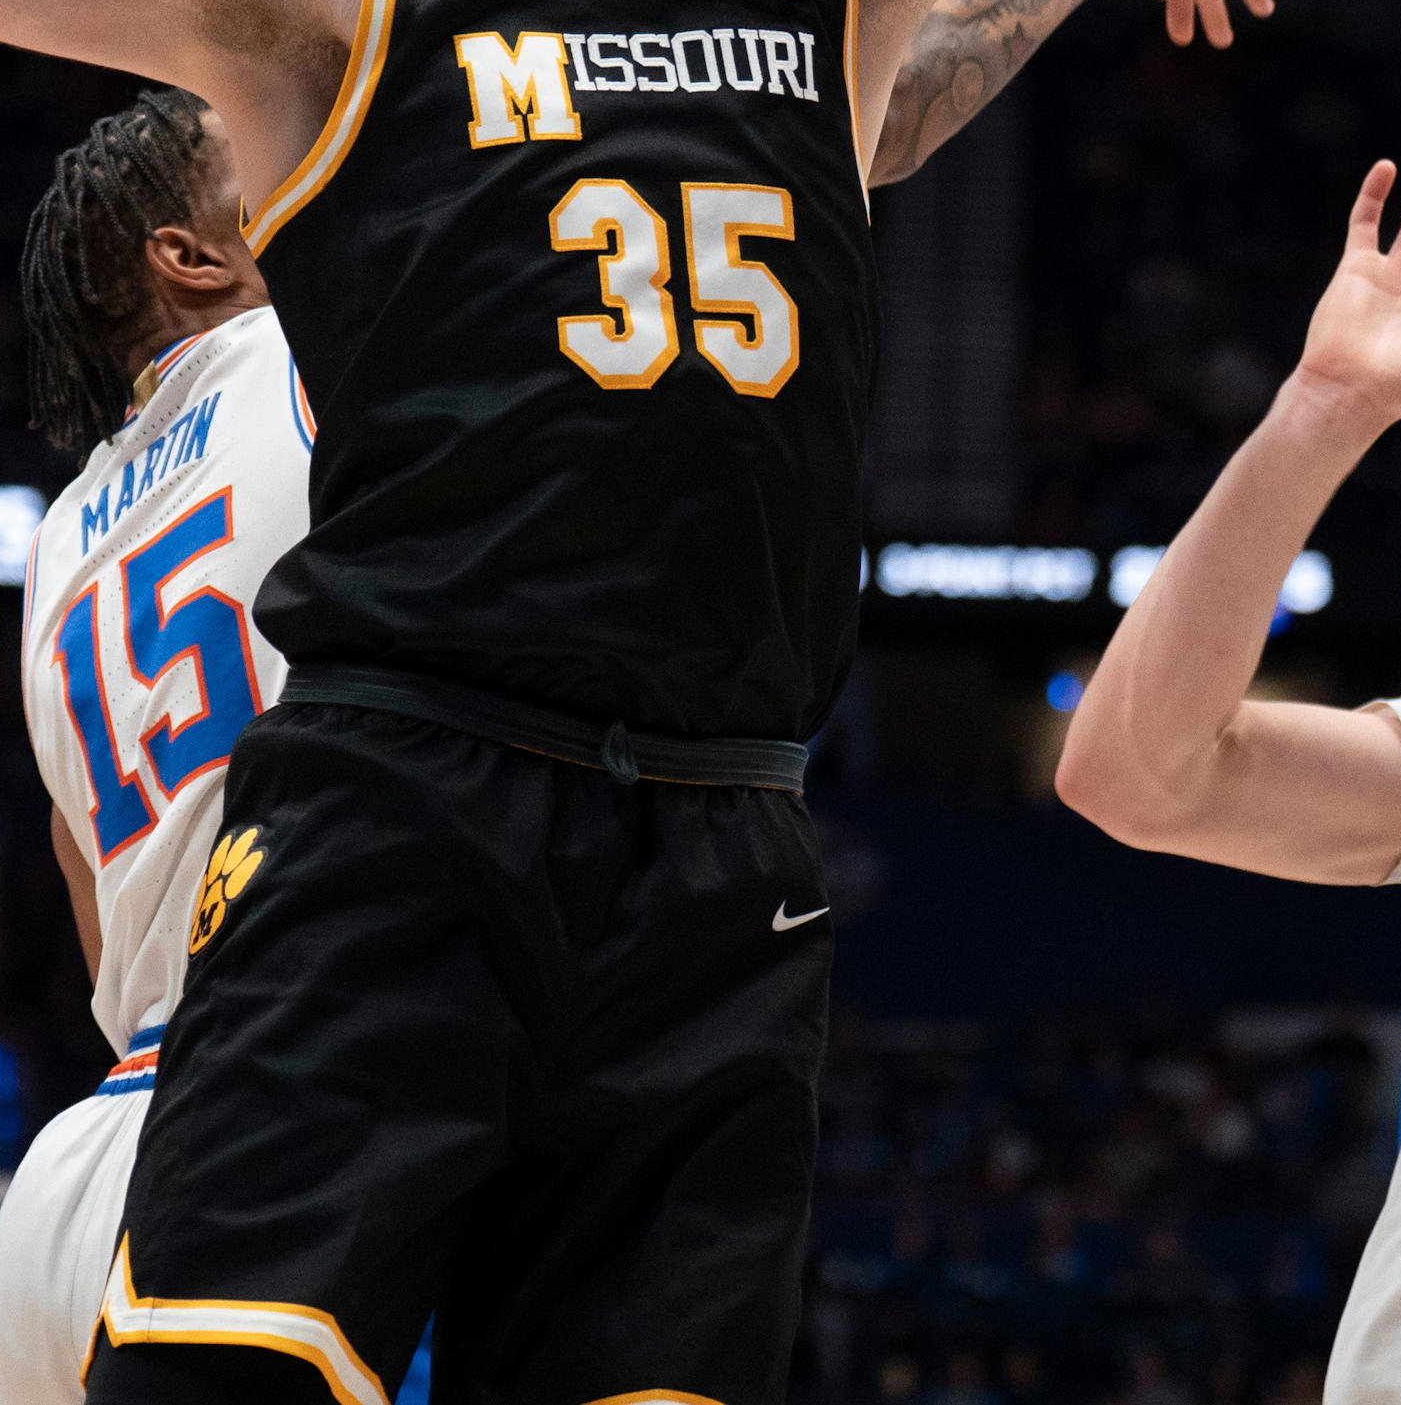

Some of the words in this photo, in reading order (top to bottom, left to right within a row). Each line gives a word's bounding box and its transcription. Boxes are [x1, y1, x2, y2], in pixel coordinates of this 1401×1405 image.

[453, 28, 820, 150] MISSOURI
[548, 178, 800, 399] 35
[81, 391, 222, 556] MARTIN
[51, 484, 263, 868] 15
